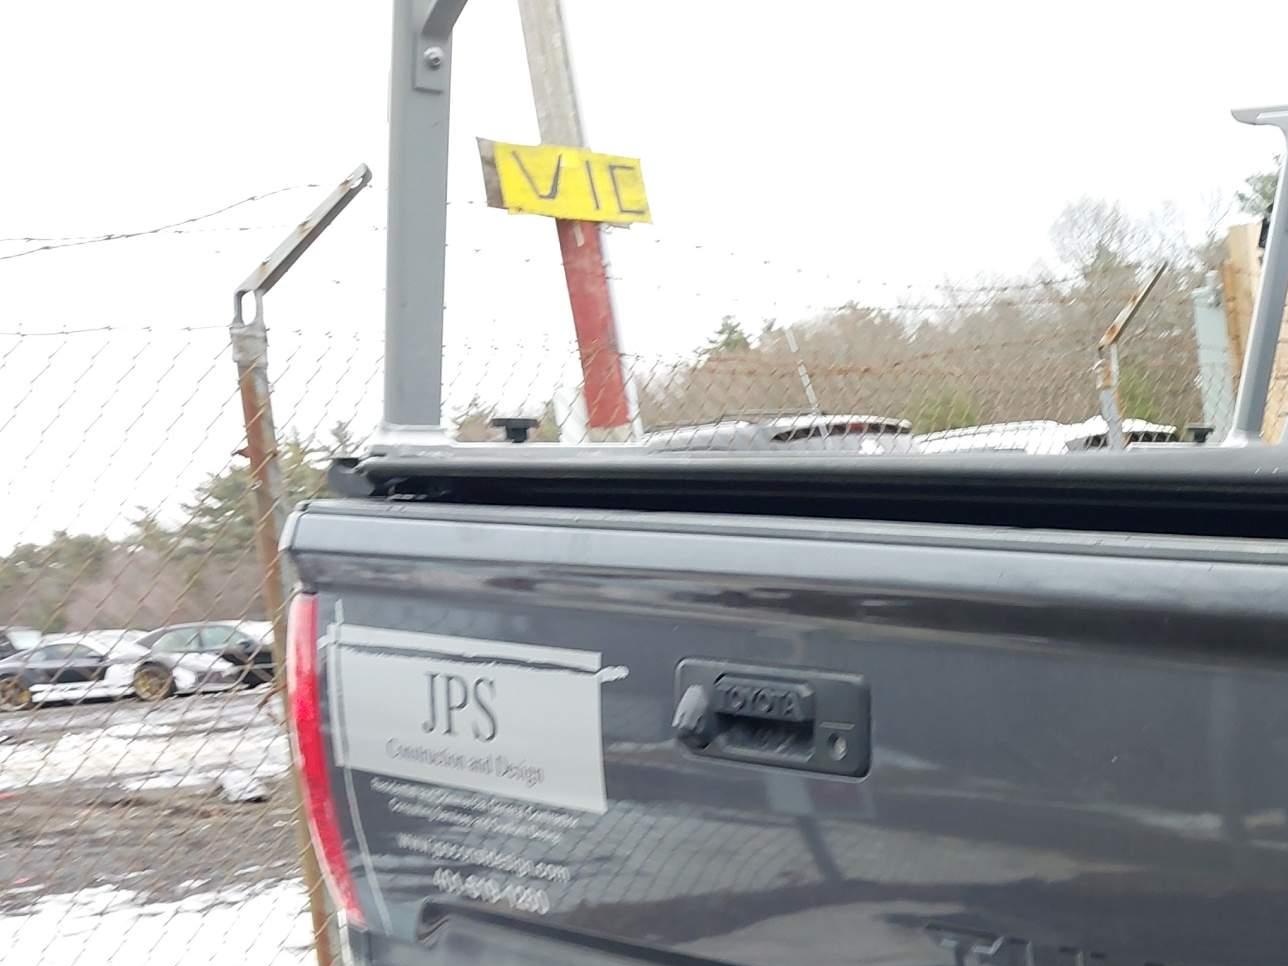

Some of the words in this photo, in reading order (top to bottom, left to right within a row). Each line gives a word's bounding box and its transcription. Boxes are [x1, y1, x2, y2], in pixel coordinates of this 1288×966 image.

[421, 671, 498, 743] JPS
[717, 684, 804, 721] TOYOTA
[385, 737, 466, 770] Construction
[468, 756, 490, 775] and
[495, 754, 545, 789] Design
